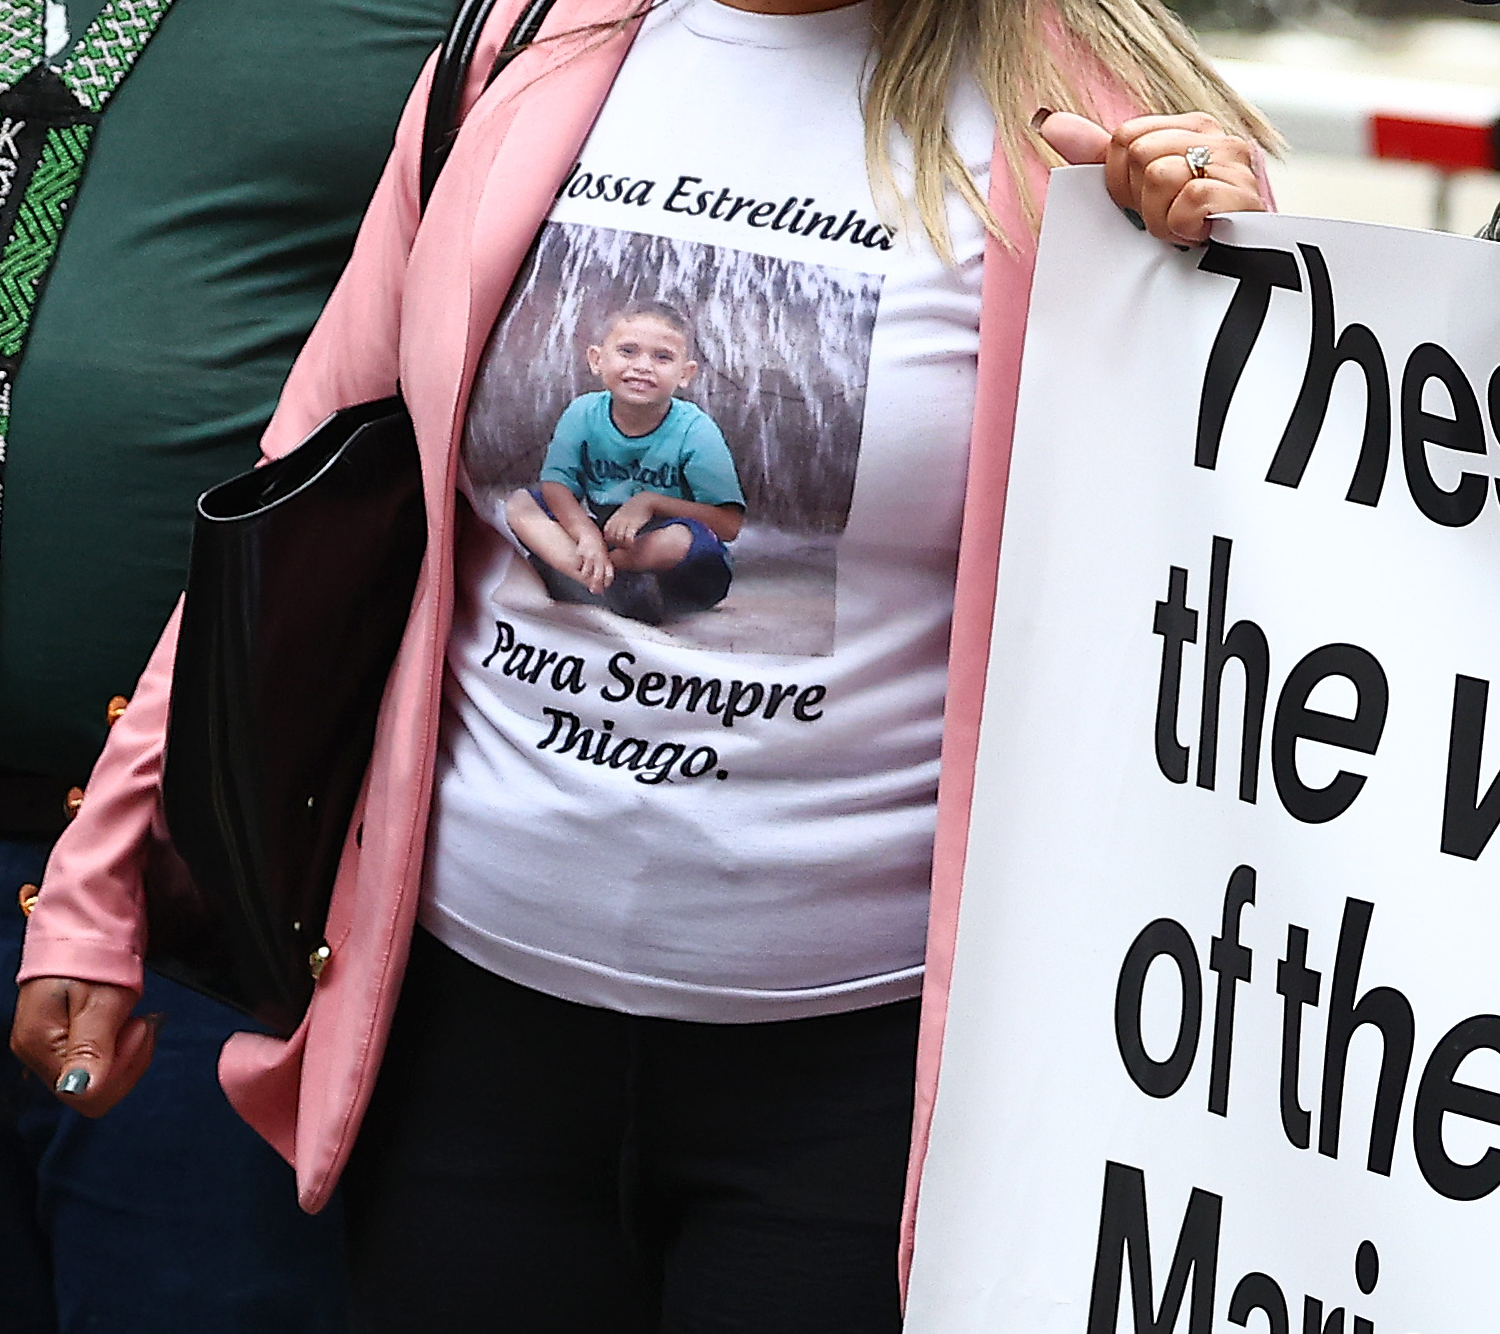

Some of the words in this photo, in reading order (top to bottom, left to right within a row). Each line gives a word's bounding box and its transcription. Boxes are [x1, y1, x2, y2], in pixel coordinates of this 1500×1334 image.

[663, 175, 896, 252] Estrelinha
[482, 621, 586, 694] Para
[600, 651, 826, 727] Sempre
[1152, 536, 1388, 823] the
[537, 707, 728, 785] Thiago.
[1115, 863, 1256, 1117] of
